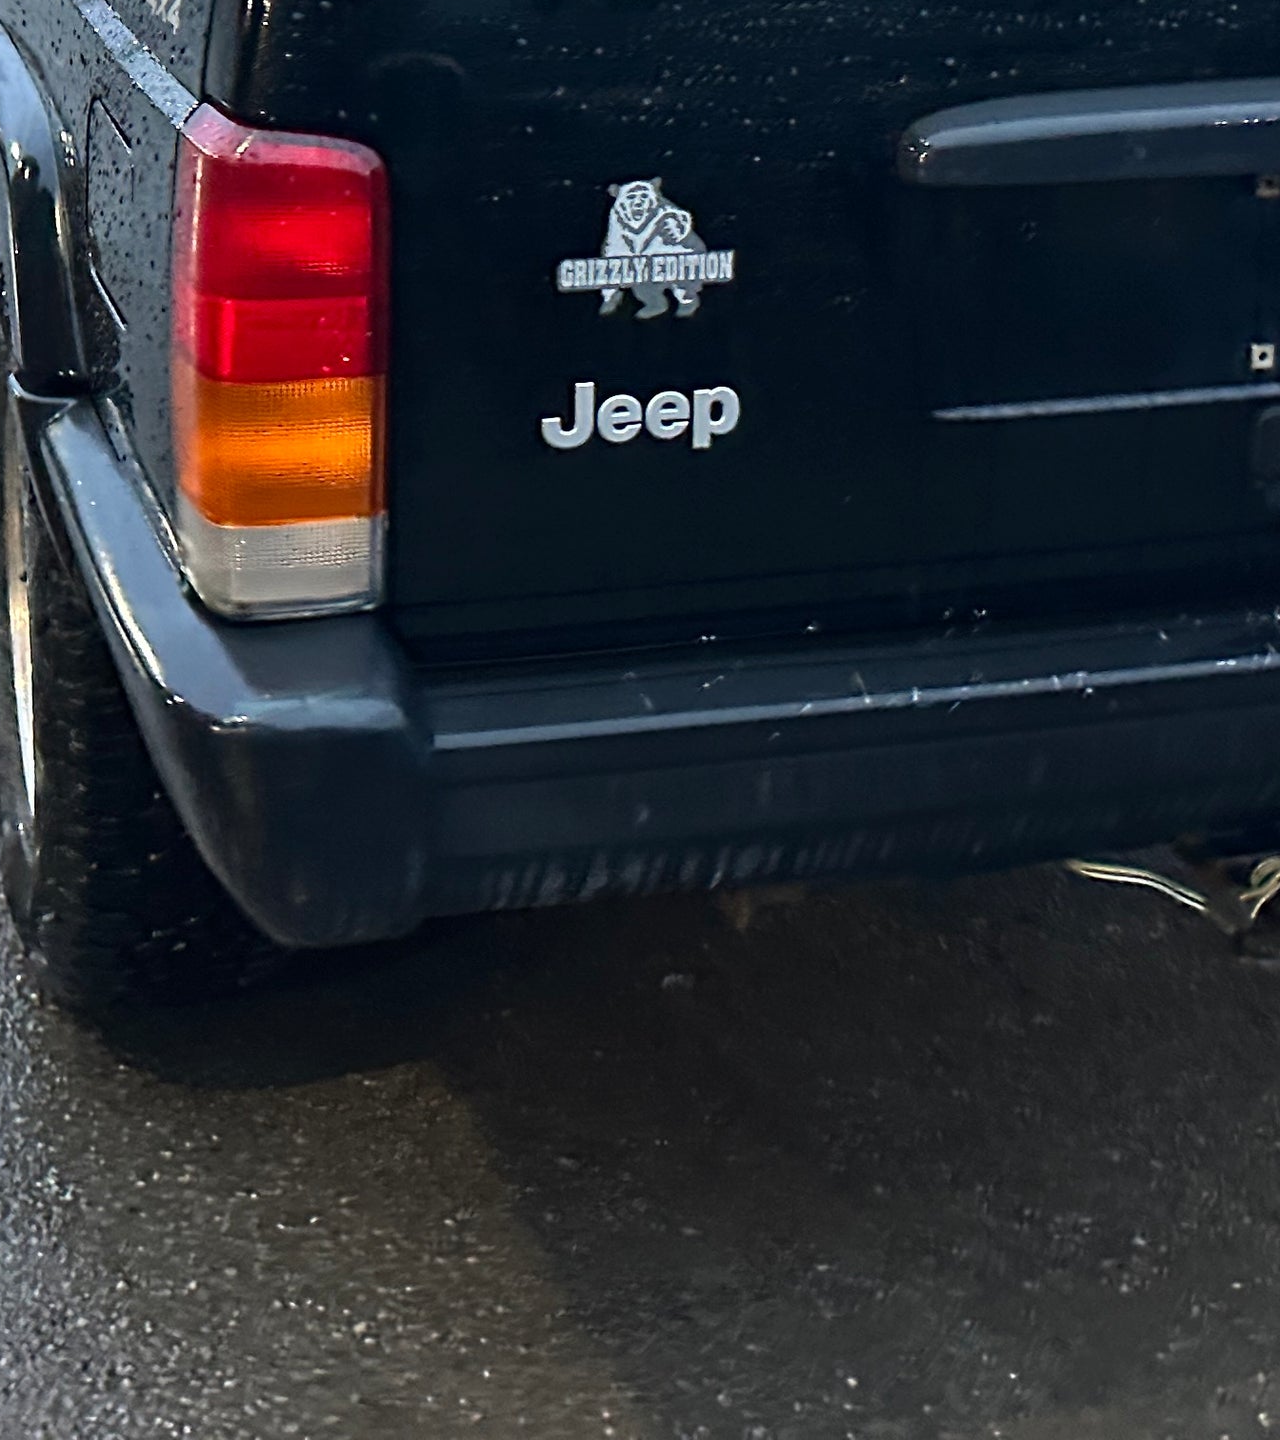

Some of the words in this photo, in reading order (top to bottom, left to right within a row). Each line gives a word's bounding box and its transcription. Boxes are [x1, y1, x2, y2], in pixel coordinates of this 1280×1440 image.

[560, 257, 648, 288] GRIZZLY
[651, 250, 734, 282] EDITION
[541, 381, 741, 450] Jeep
